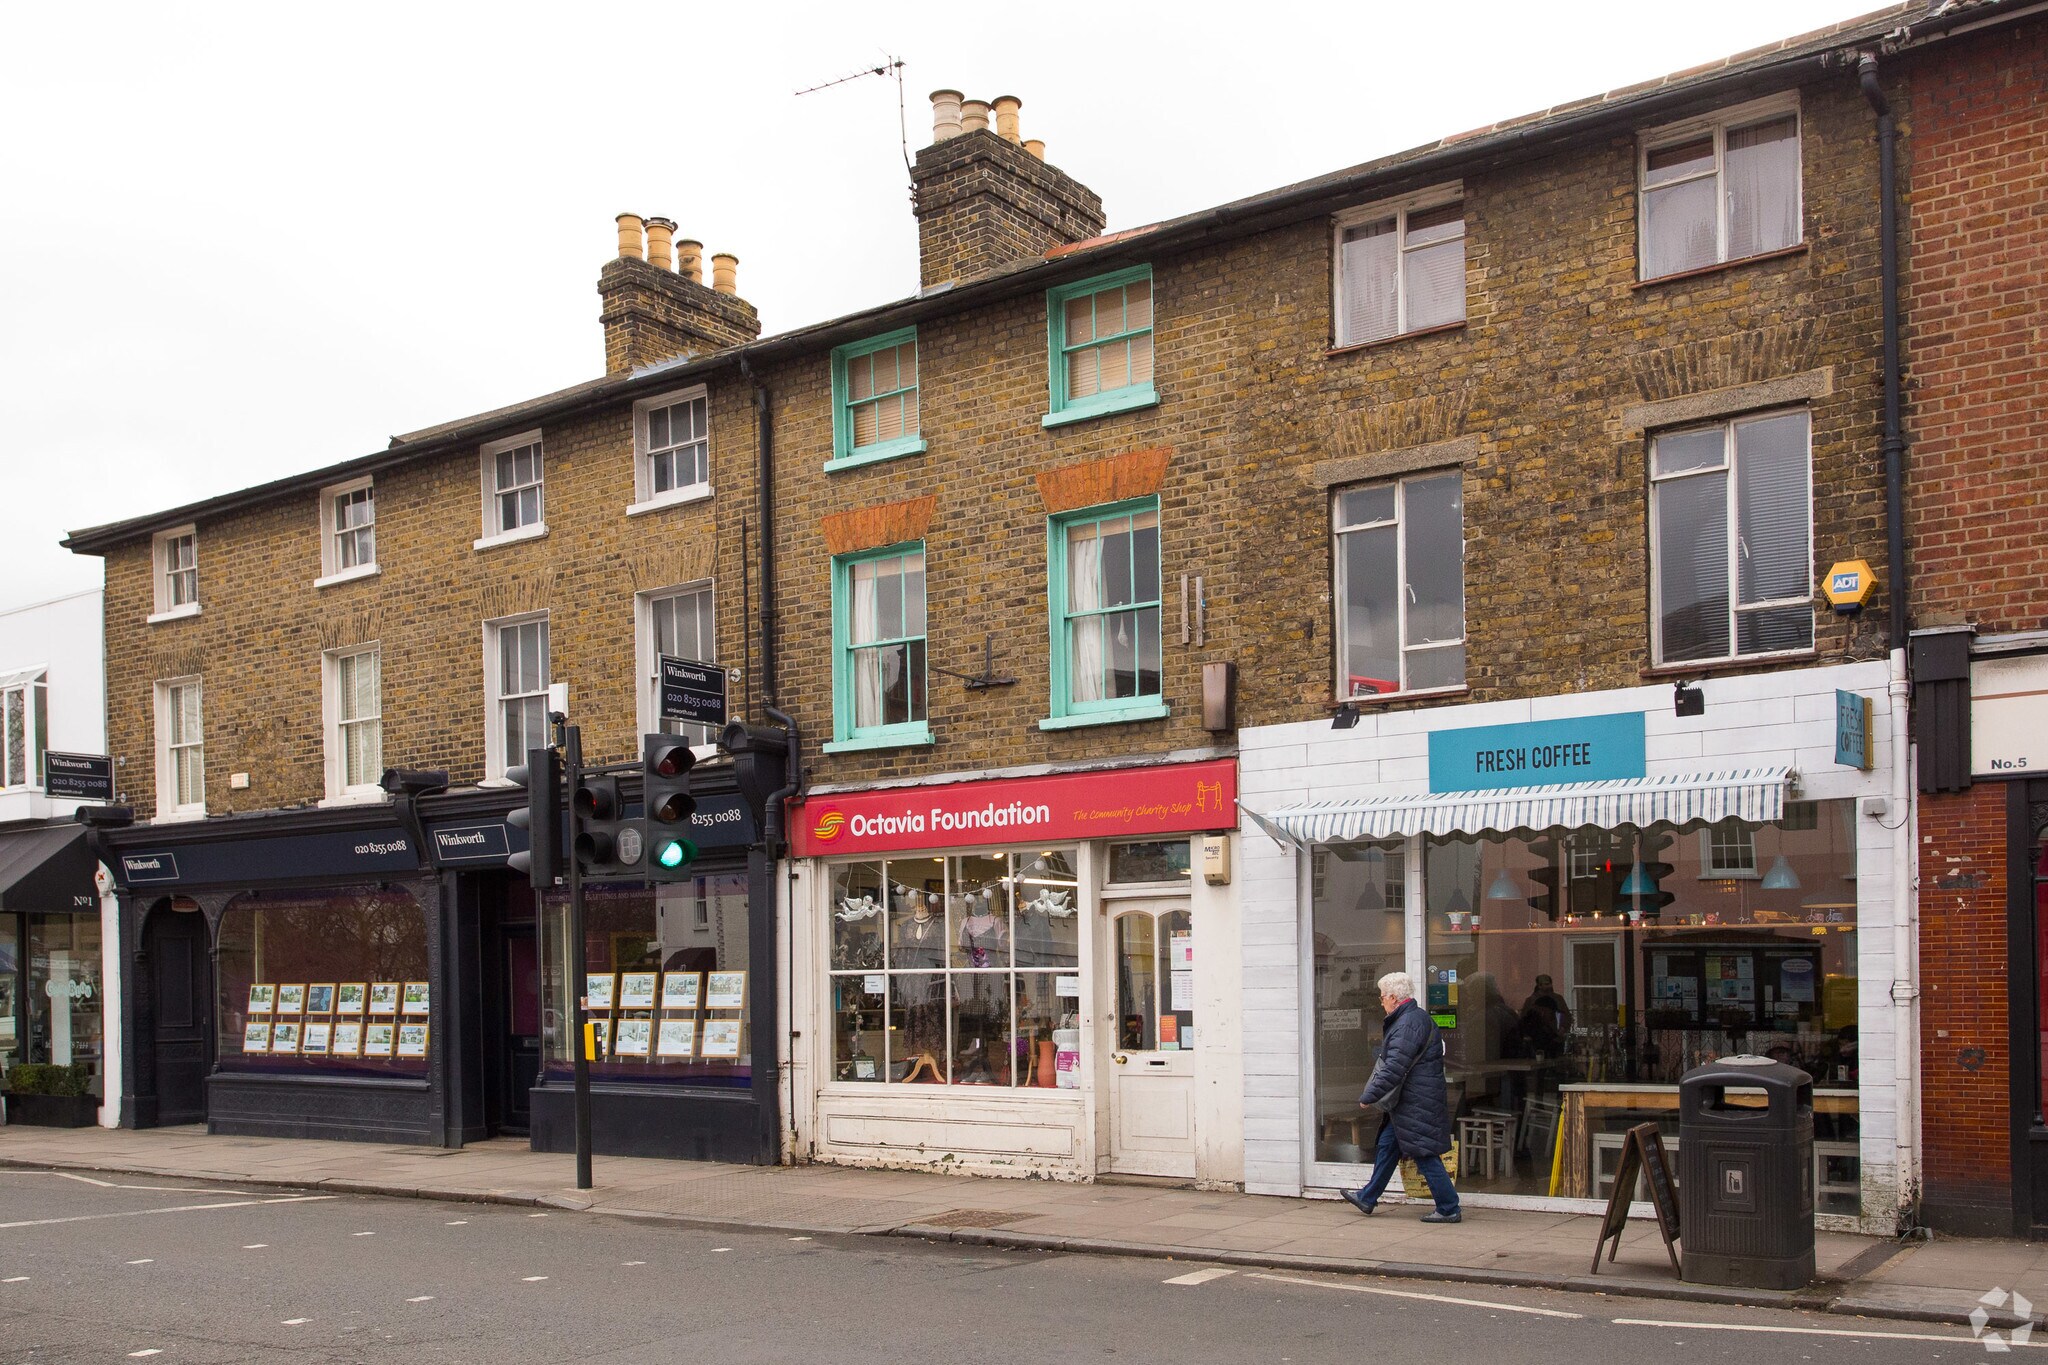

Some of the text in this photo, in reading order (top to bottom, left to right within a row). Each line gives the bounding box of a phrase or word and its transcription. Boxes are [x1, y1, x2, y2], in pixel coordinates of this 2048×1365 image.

[1833, 576, 1859, 589] ADT
[667, 666, 706, 681] Winkworth
[667, 693, 721, 709] 020 8255 0088
[1840, 730, 1863, 756] COFFEE
[51, 758, 92, 769] Winkworth
[1476, 742, 1591, 773] FRESH COFFEE
[1991, 757, 2028, 770] No.5
[52, 777, 108, 789] 020 8255 0088
[691, 808, 742, 827] 8255 0088
[850, 800, 1050, 837] Octavia Foundation
[1073, 801, 1193, 823] The Community Charity Shop
[354, 839, 407, 855] 020 8255 0088
[438, 831, 486, 847] Winkworth
[125, 858, 161, 871] Winkworth
